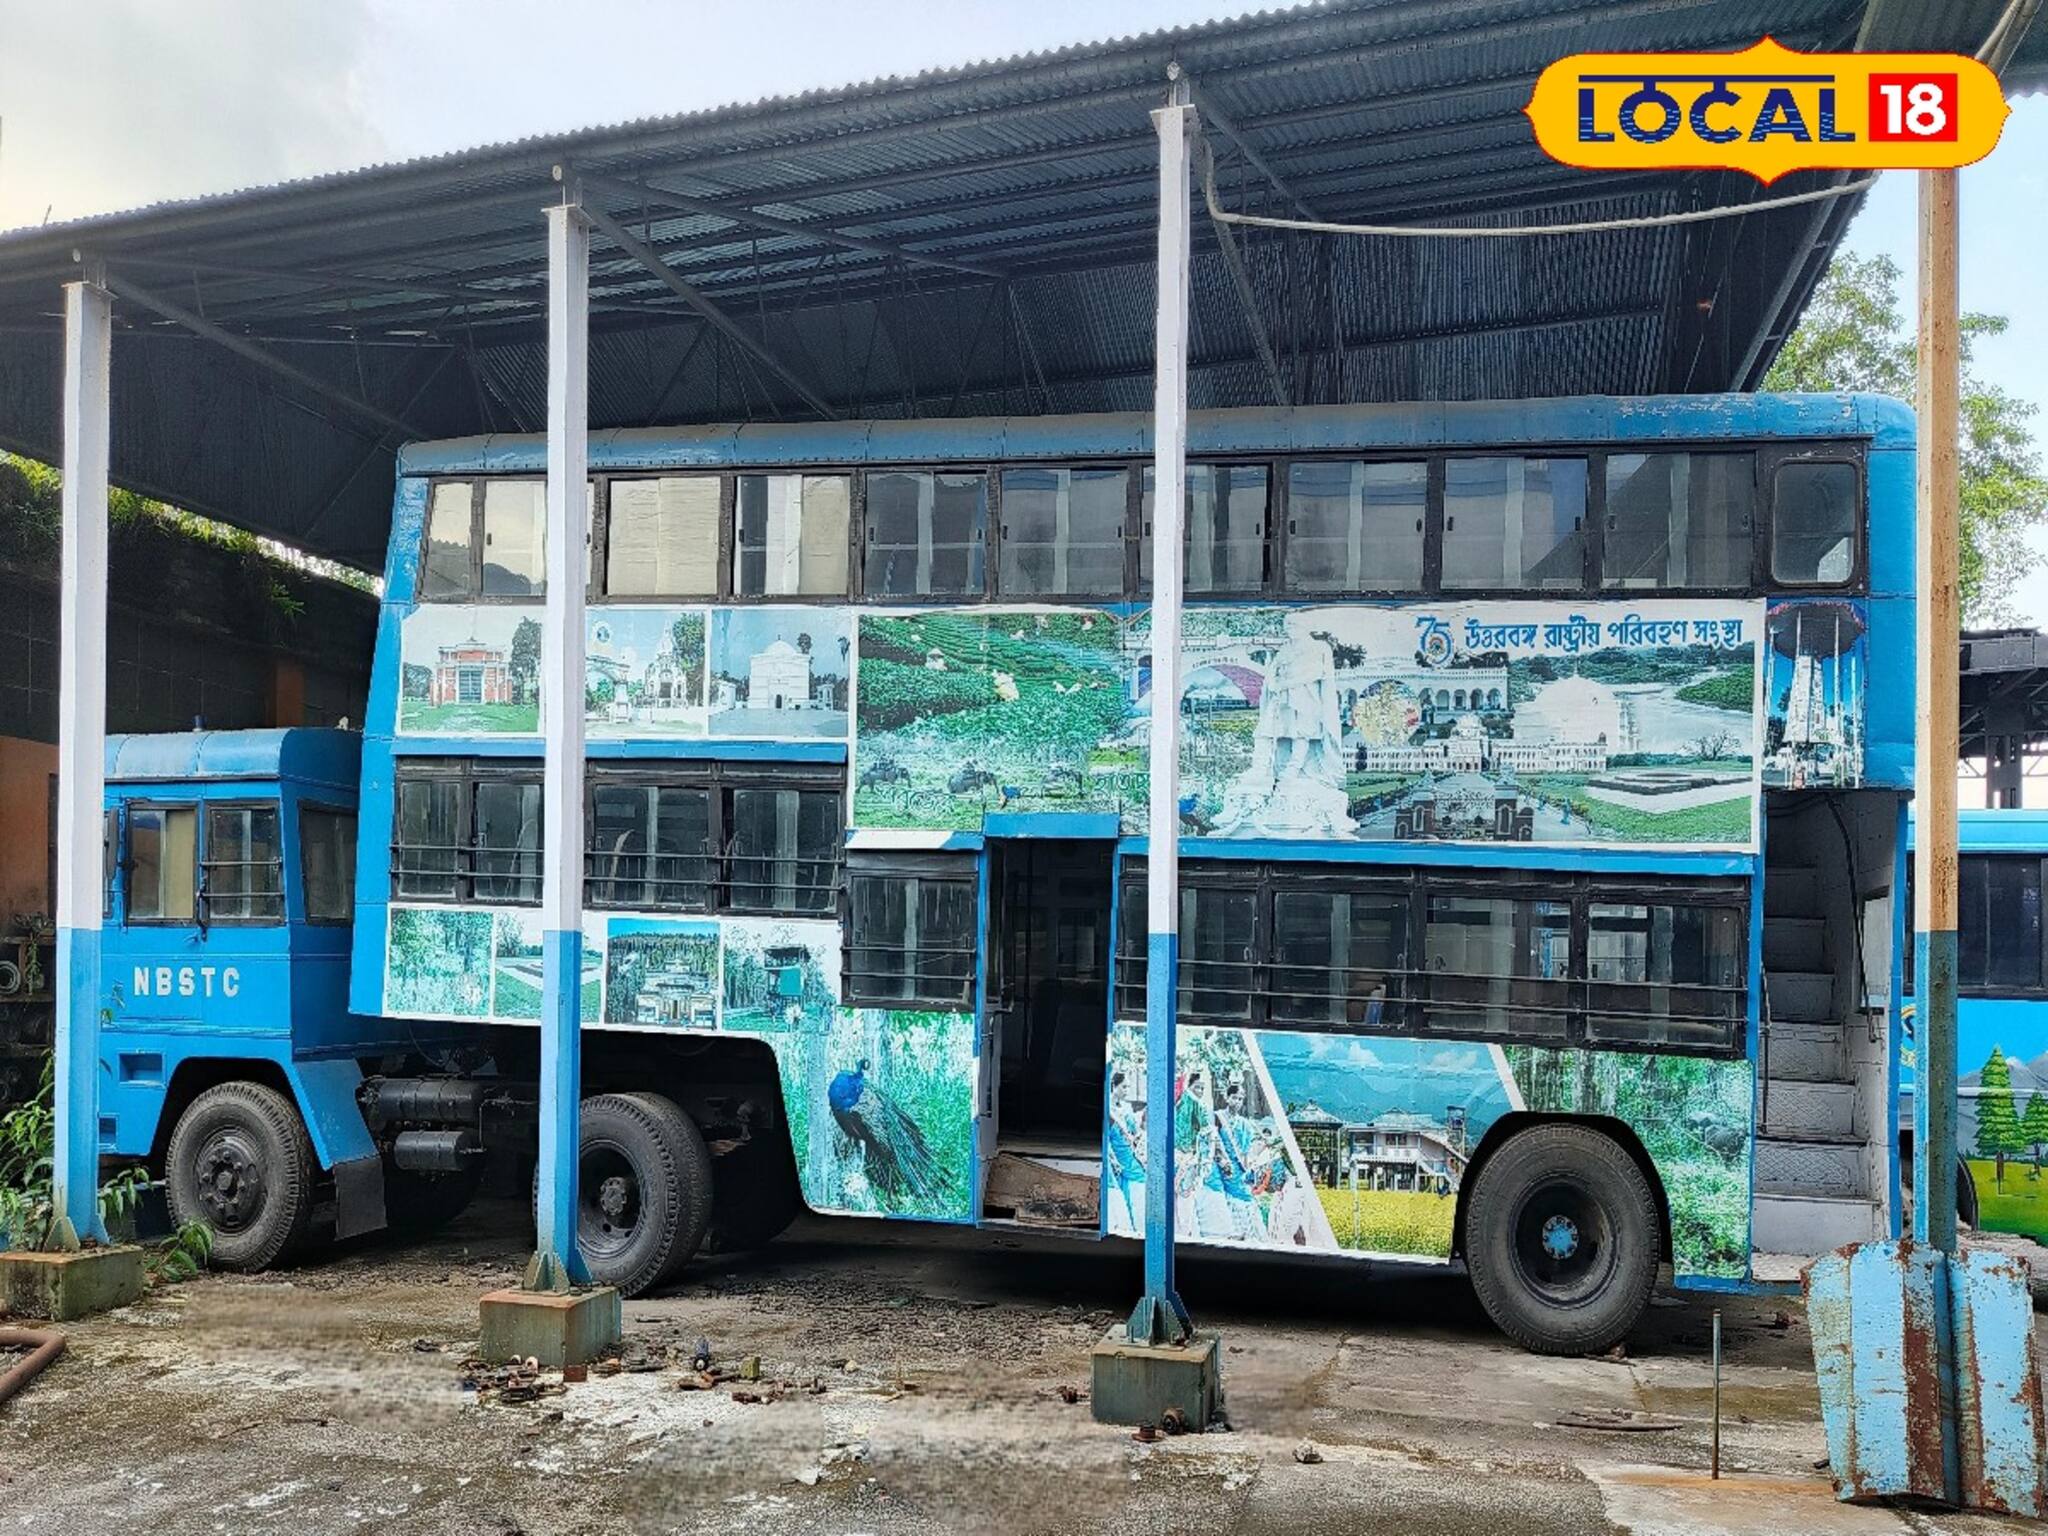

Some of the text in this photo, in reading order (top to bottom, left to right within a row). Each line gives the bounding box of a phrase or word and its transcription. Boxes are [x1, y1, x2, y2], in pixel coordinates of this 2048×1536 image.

[1464, 618, 1539, 649] উত্তরবঙ্গ
[1544, 614, 1601, 652] রাষ্ট্রীয়
[1608, 613, 1689, 646] পরিবহণ
[1693, 619, 1744, 648] সংস্থা
[133, 966, 240, 998] NBSTC
